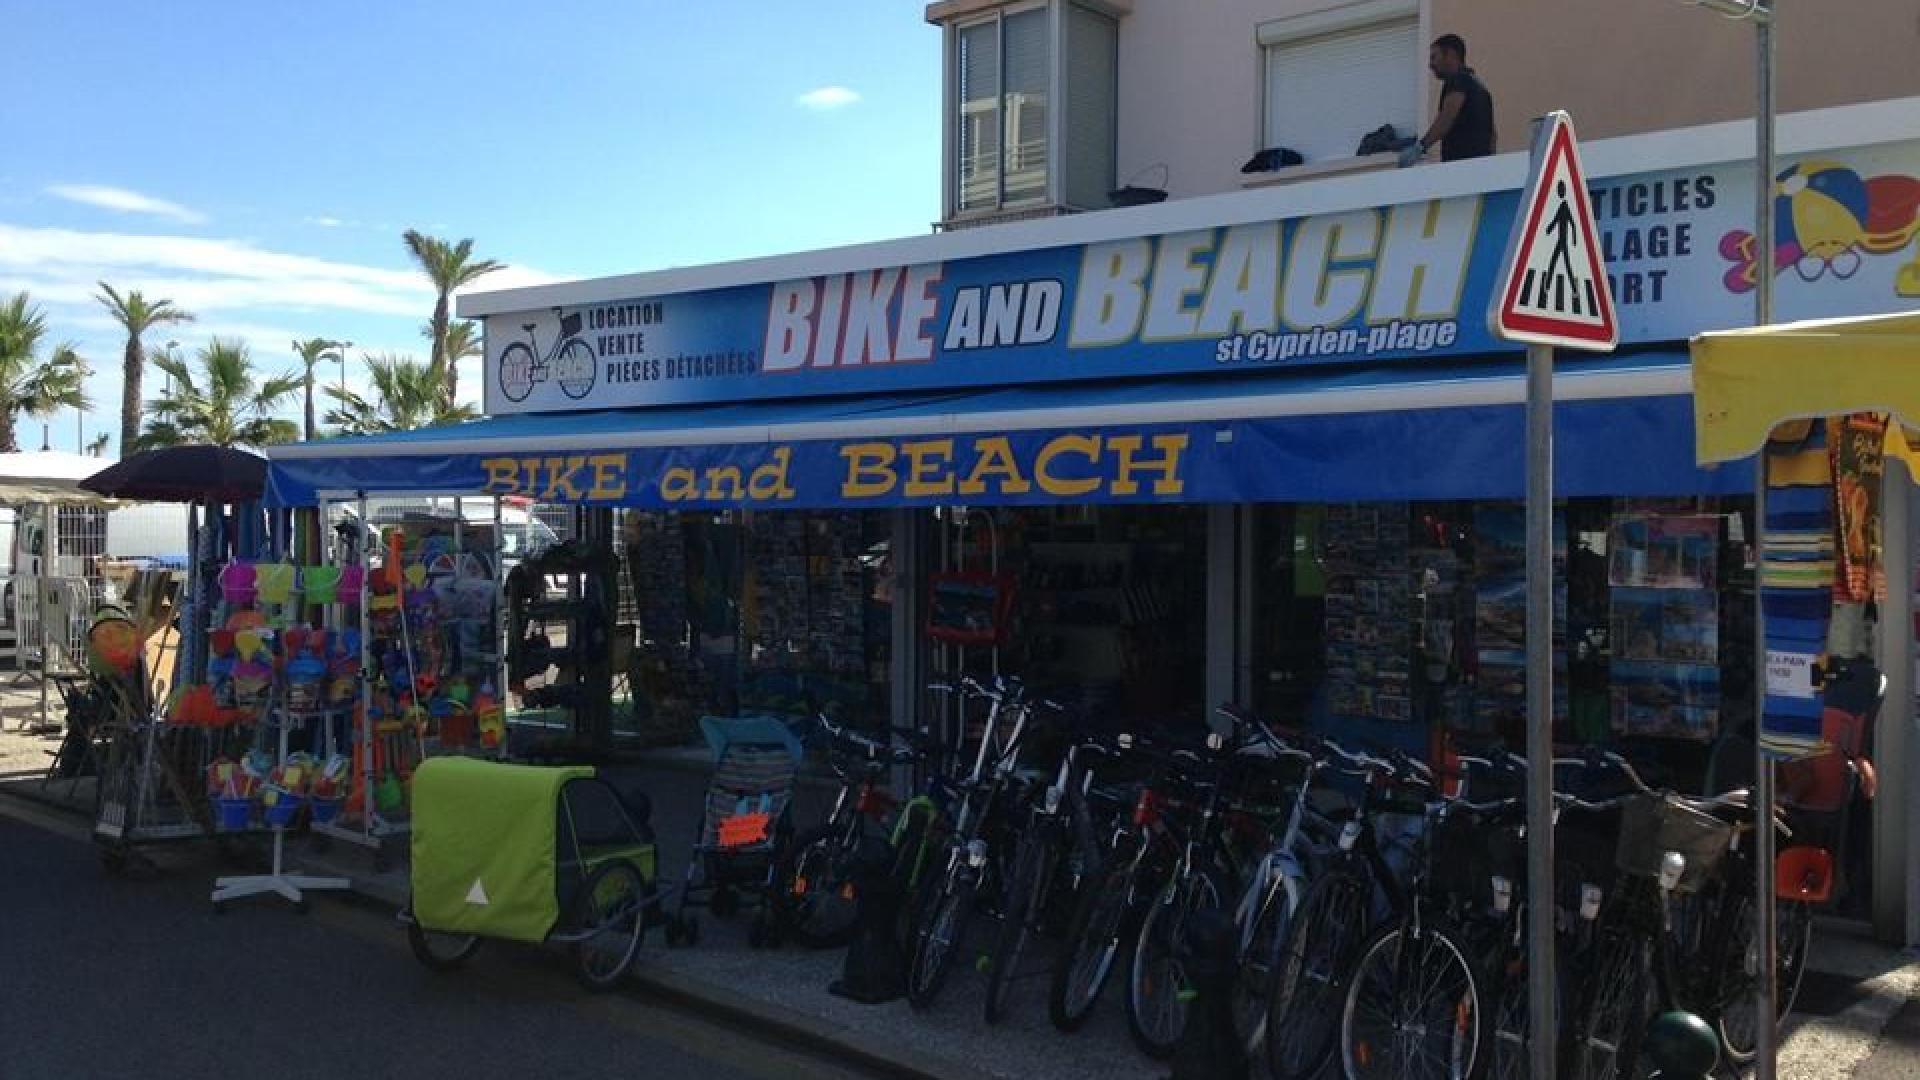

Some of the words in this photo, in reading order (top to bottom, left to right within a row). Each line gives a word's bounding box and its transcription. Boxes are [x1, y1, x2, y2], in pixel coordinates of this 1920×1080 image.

[1589, 175, 1715, 220] TICLES
[1603, 223, 1691, 262] LAGE
[761, 263, 944, 374] BIKE
[943, 279, 1063, 351] AND
[1067, 194, 1483, 348] BEACH
[589, 303, 663, 330] LOCATION
[598, 332, 645, 357] VENTE
[1215, 333, 1243, 363] st
[1246, 320, 1458, 359] Cyprien-plage
[607, 356, 660, 385] PIÈCES
[480, 453, 626, 500] BIKE
[661, 447, 796, 502] and
[840, 434, 1189, 497] BEACH
